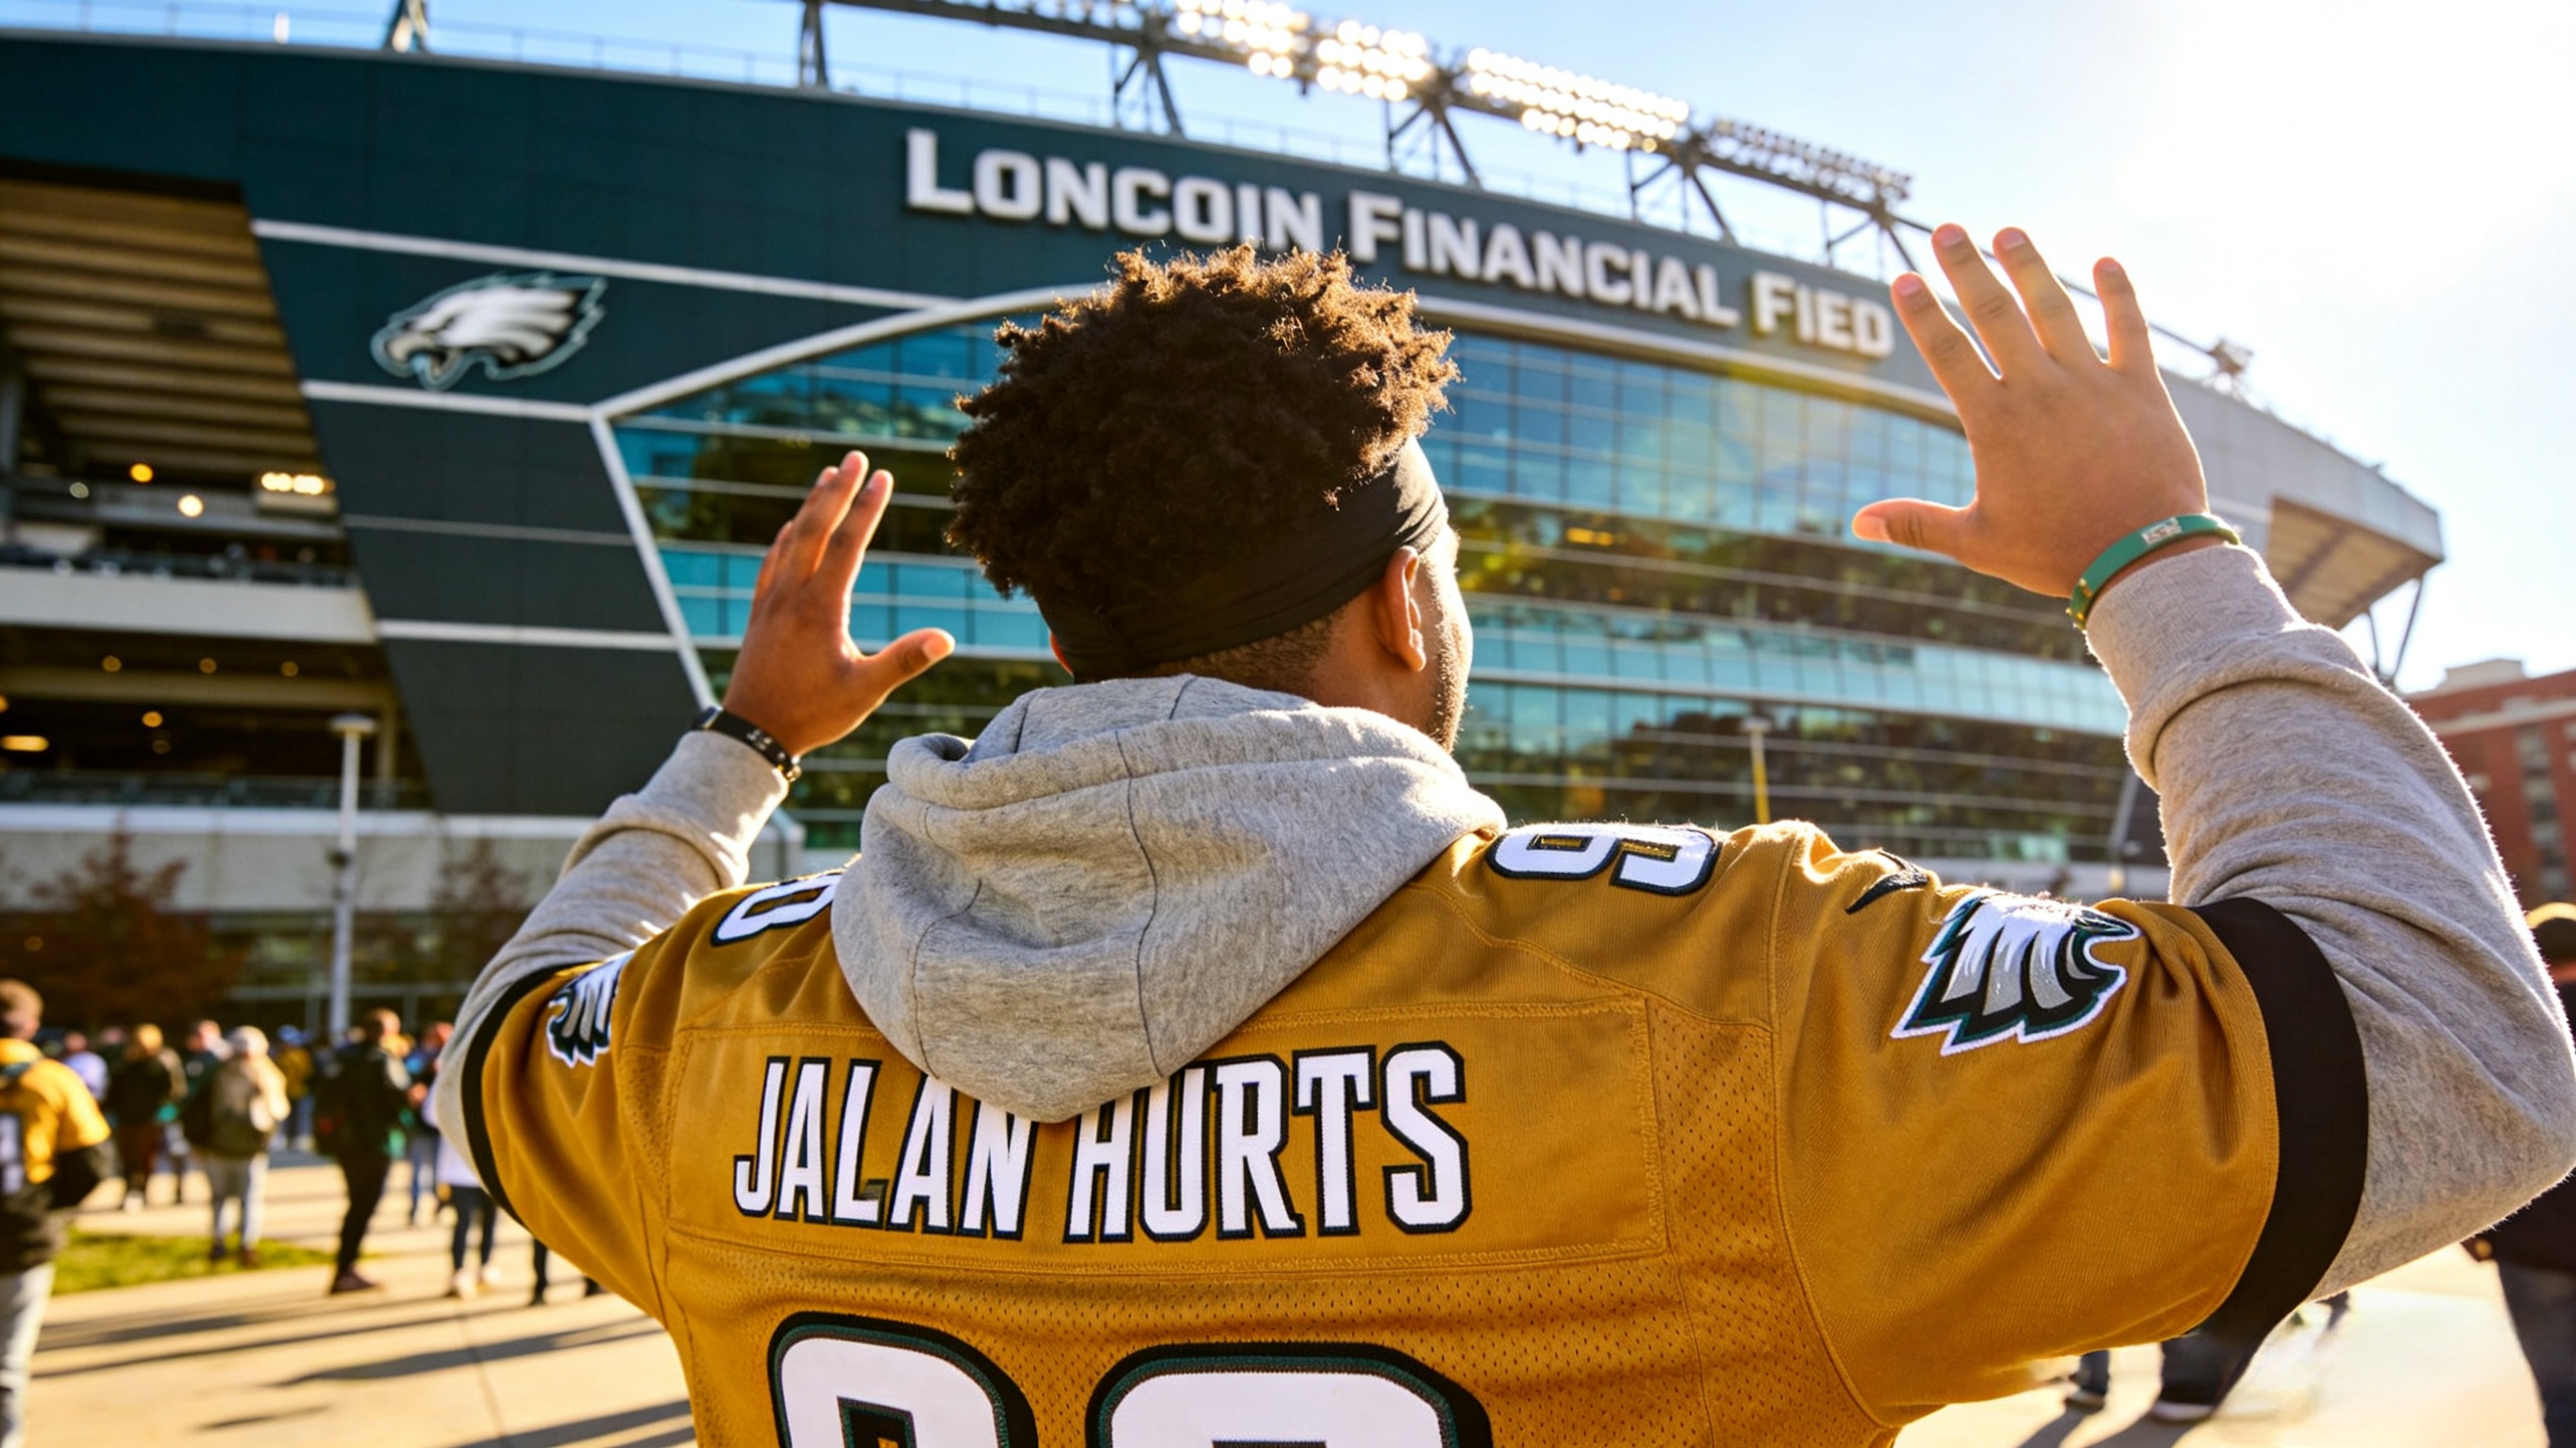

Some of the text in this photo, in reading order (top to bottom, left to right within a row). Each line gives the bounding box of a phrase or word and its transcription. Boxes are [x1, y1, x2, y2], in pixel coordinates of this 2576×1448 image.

[907, 127, 1895, 358] LONCOIN FINANCIAL FIED
[733, 1040, 1472, 1243] JALAN HURTS
